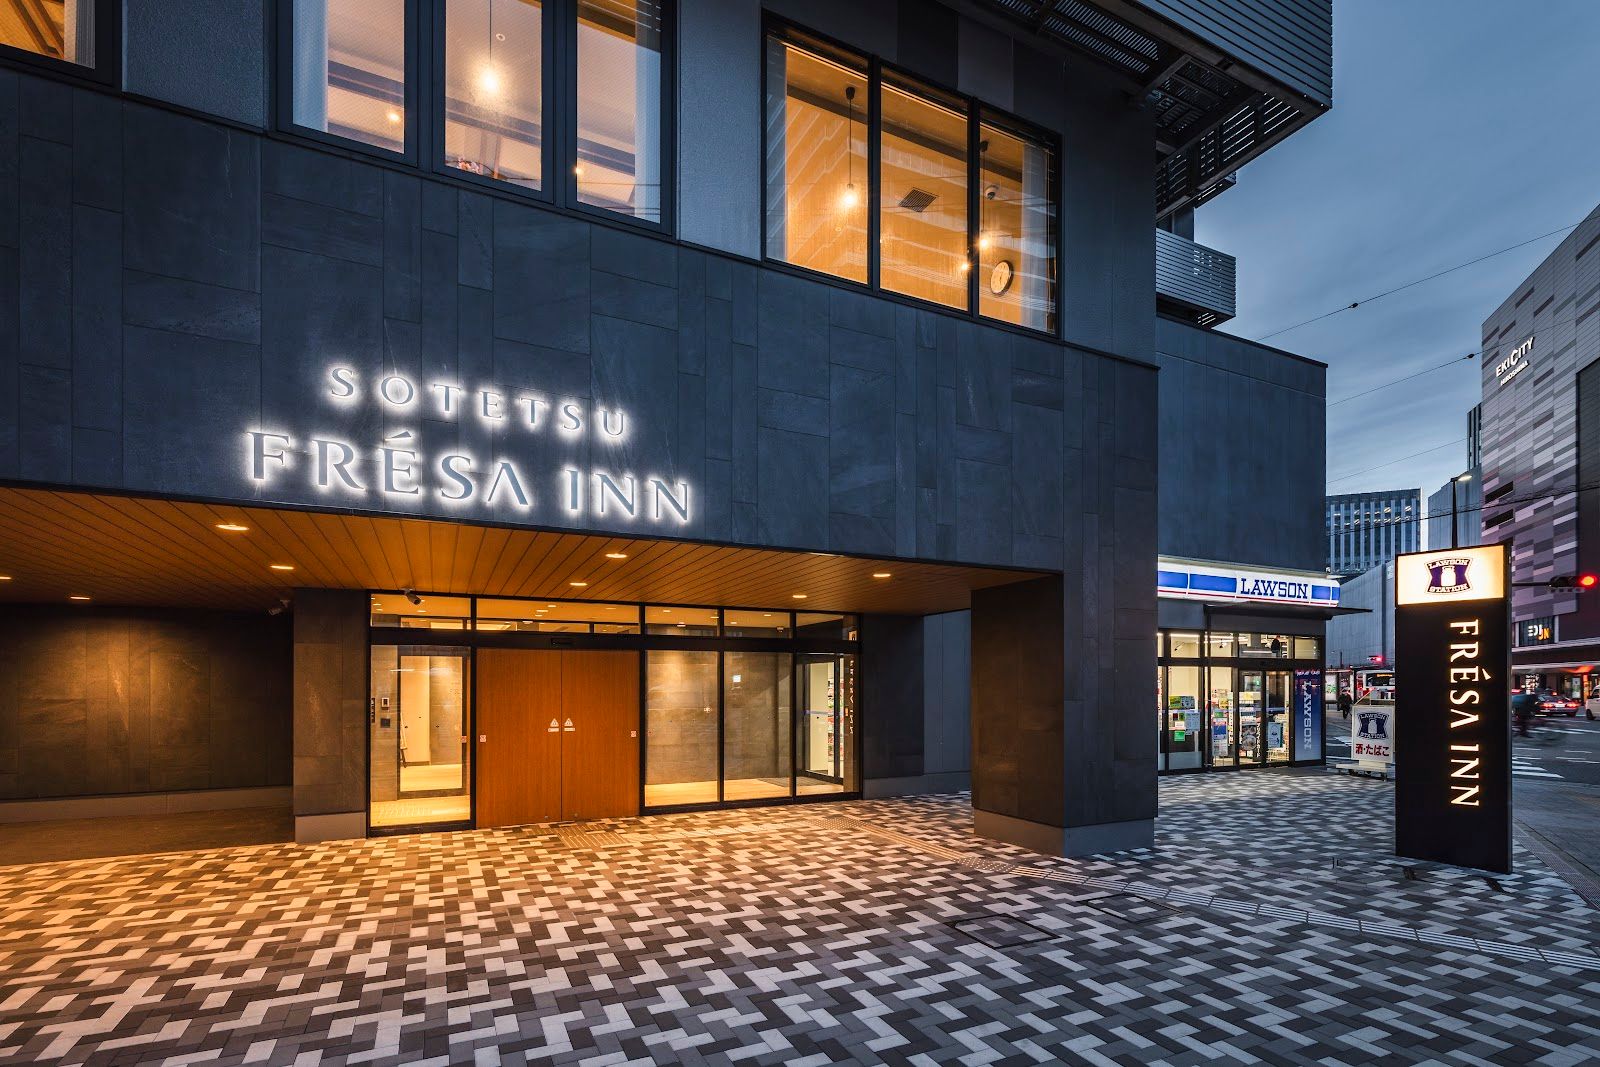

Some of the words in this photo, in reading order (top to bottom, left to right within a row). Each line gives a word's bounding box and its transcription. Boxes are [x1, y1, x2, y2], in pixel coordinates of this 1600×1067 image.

[330, 366, 626, 437] SOTETSU
[246, 430, 530, 507] FRÉSA
[565, 469, 689, 523] INN
[1240, 578, 1309, 600] LAWSON
[1428, 559, 1470, 570] LAWSON
[1428, 583, 1470, 593] STATION
[1449, 618, 1492, 729] FRÉSA
[1303, 680, 1312, 750] LAWSON
[1450, 743, 1480, 812] INN
